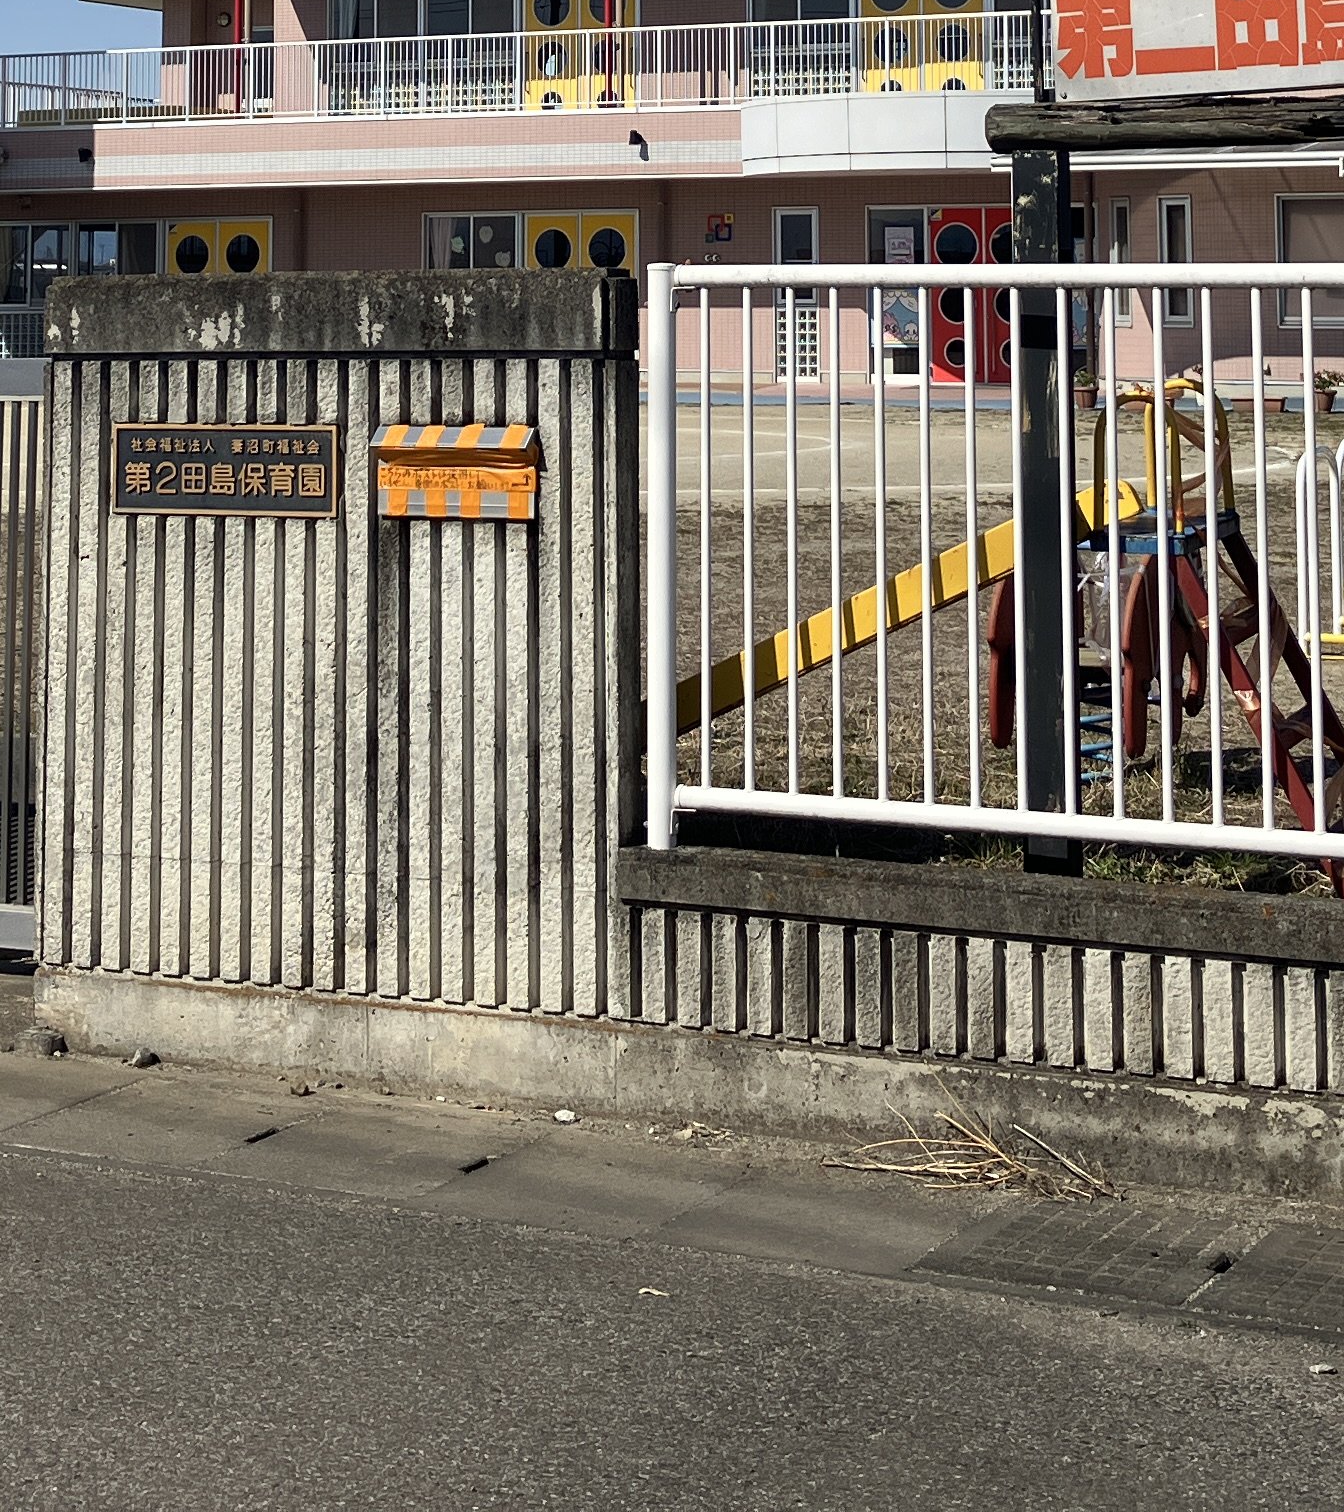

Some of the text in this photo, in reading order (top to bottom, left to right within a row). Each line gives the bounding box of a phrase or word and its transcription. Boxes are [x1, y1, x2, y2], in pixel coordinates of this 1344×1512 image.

[131, 437, 215, 453] 社会福祉法人
[124, 461, 326, 497] 第2田島保育園
